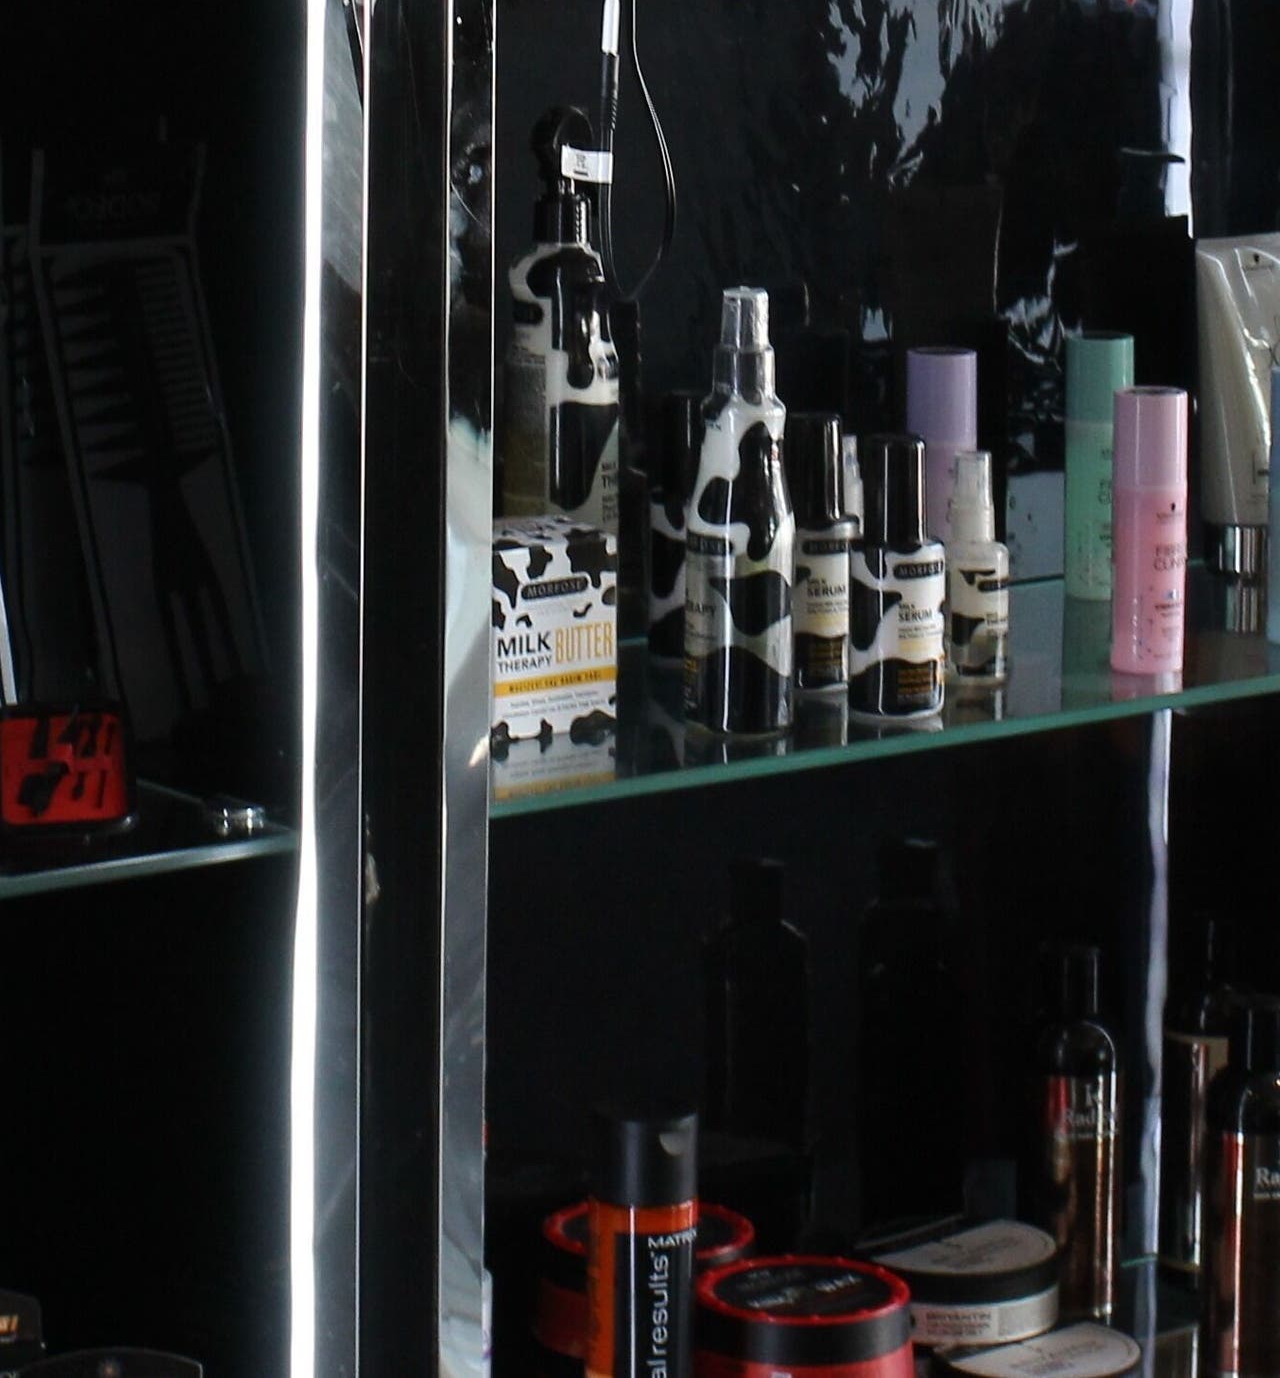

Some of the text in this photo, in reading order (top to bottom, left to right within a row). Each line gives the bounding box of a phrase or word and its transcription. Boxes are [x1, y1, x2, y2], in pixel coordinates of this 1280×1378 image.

[897, 606, 934, 623] SERUM
[497, 622, 612, 665] MILK BUTTER
[498, 654, 552, 674] THERAPY
[648, 1253, 669, 1356] results
